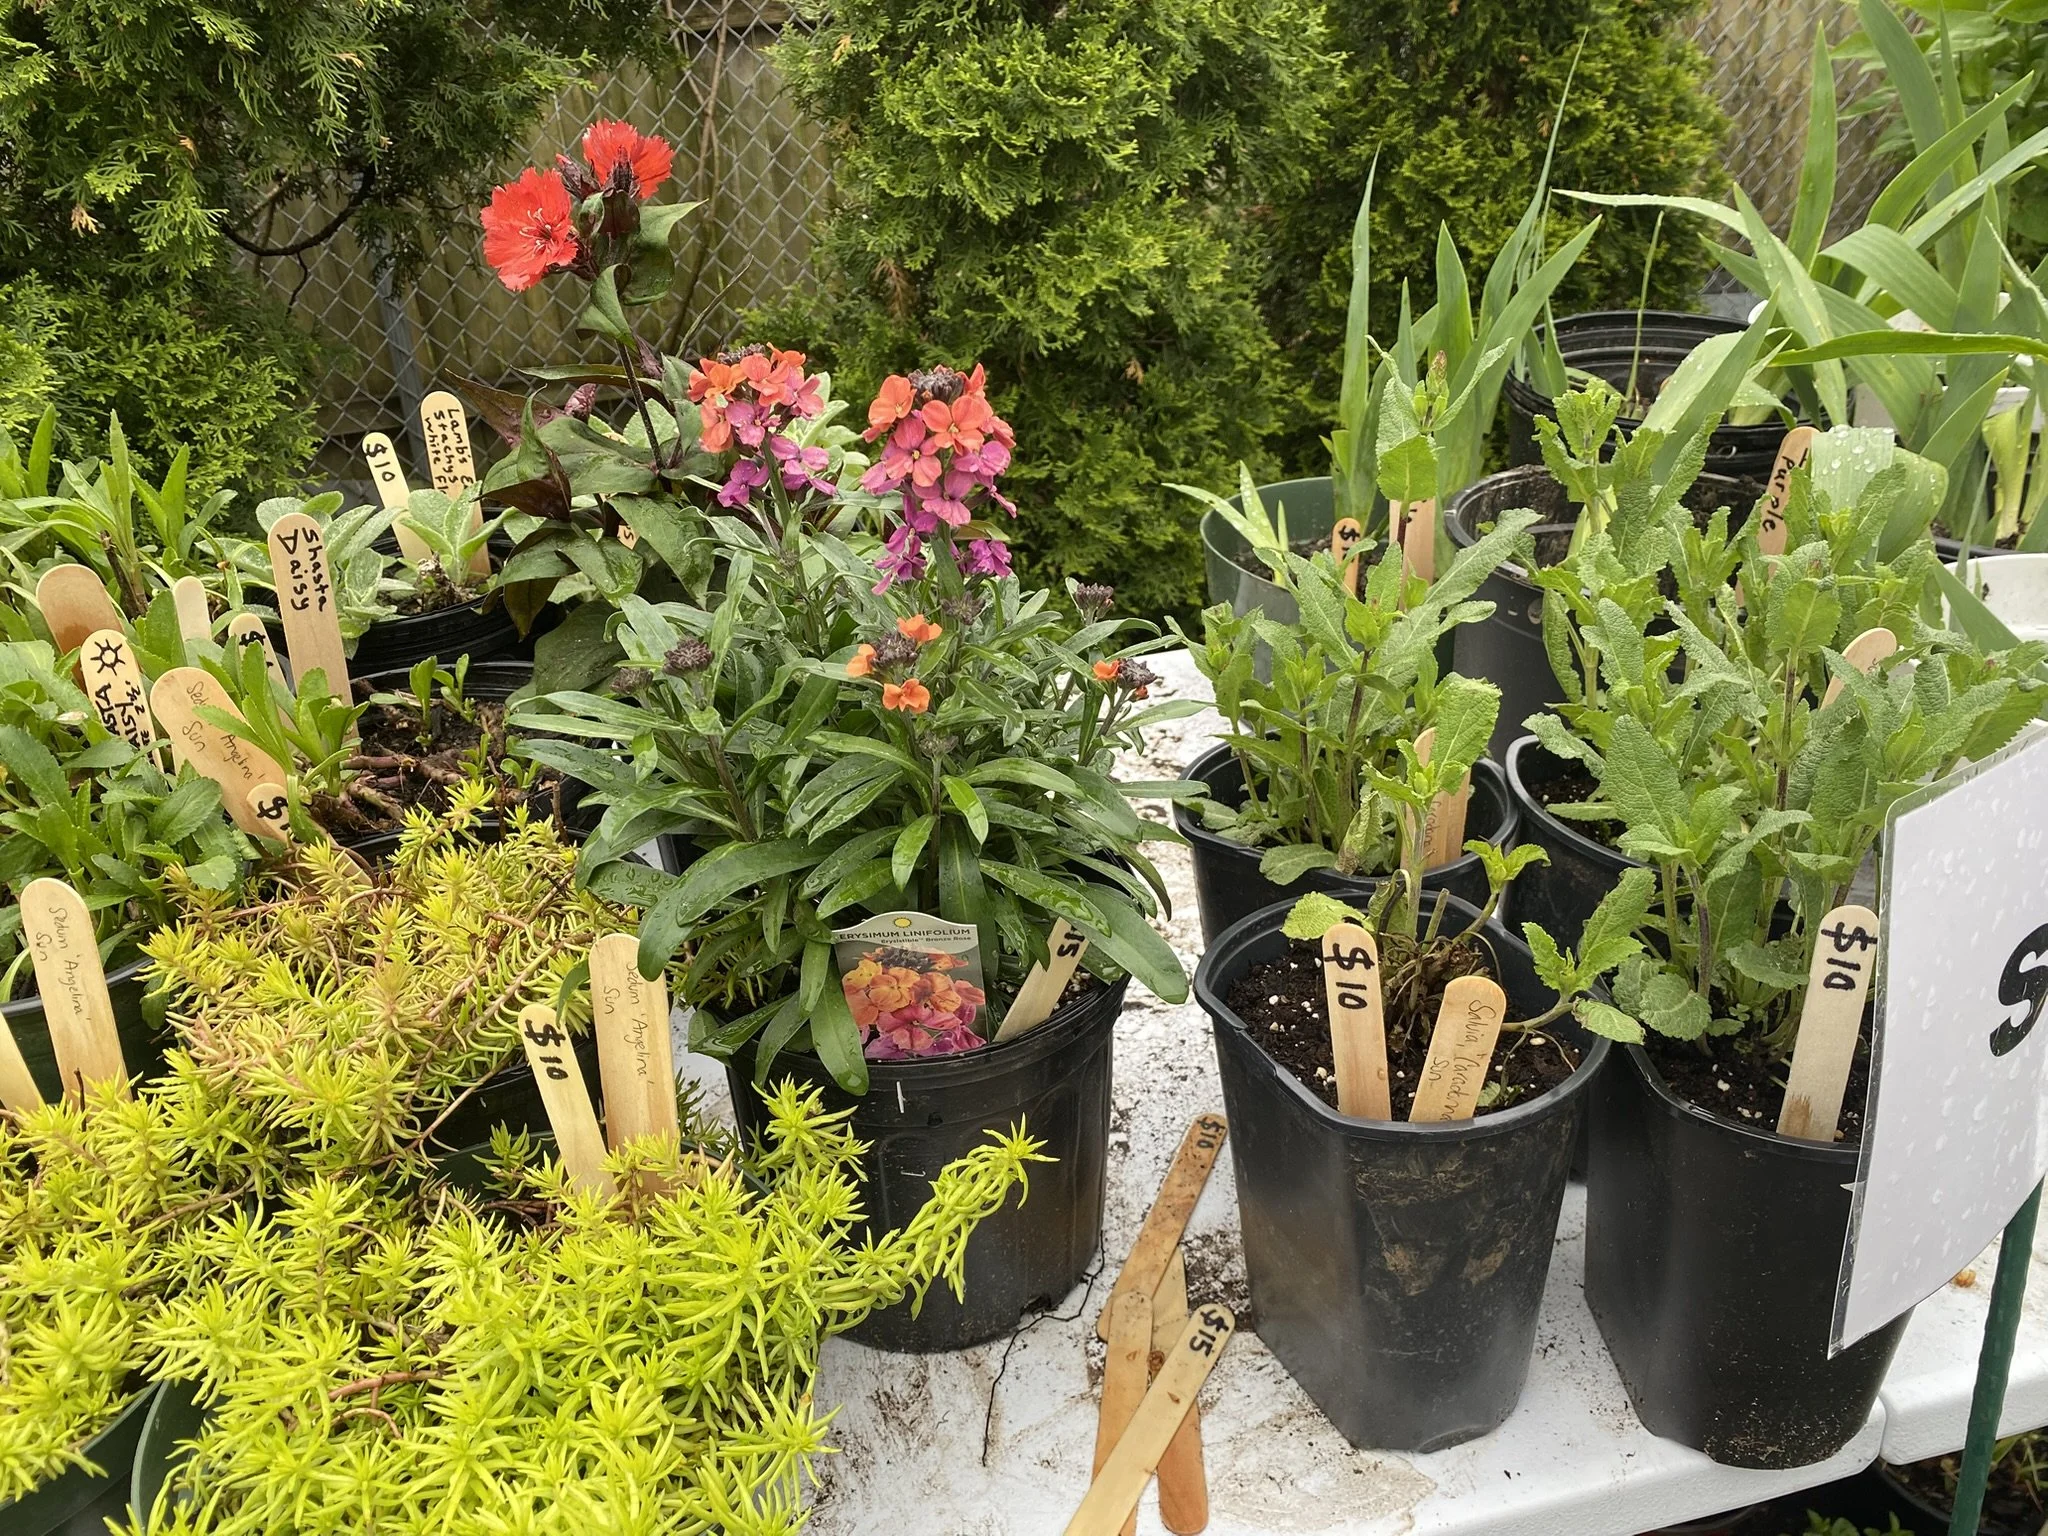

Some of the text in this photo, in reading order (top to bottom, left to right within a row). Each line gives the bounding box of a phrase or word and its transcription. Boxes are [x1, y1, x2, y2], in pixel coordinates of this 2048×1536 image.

[365, 443, 396, 482] $10
[276, 528, 310, 611] Daisy
[302, 527, 329, 612] Shasta
[115, 701, 140, 751] AISY
[182, 720, 206, 753] Sun
[36, 932, 52, 962] Sun
[49, 907, 70, 950] Sedum
[839, 928, 971, 940] ERYSIMUM LINIFOLIUM
[1057, 925, 1086, 958] 15
[1324, 943, 1376, 1010] $10
[1821, 921, 1877, 991] $10
[603, 987, 621, 1015] Sun
[524, 1019, 569, 1080] $10
[1197, 1116, 1226, 1149] $10
[1189, 1309, 1230, 1358] $15
